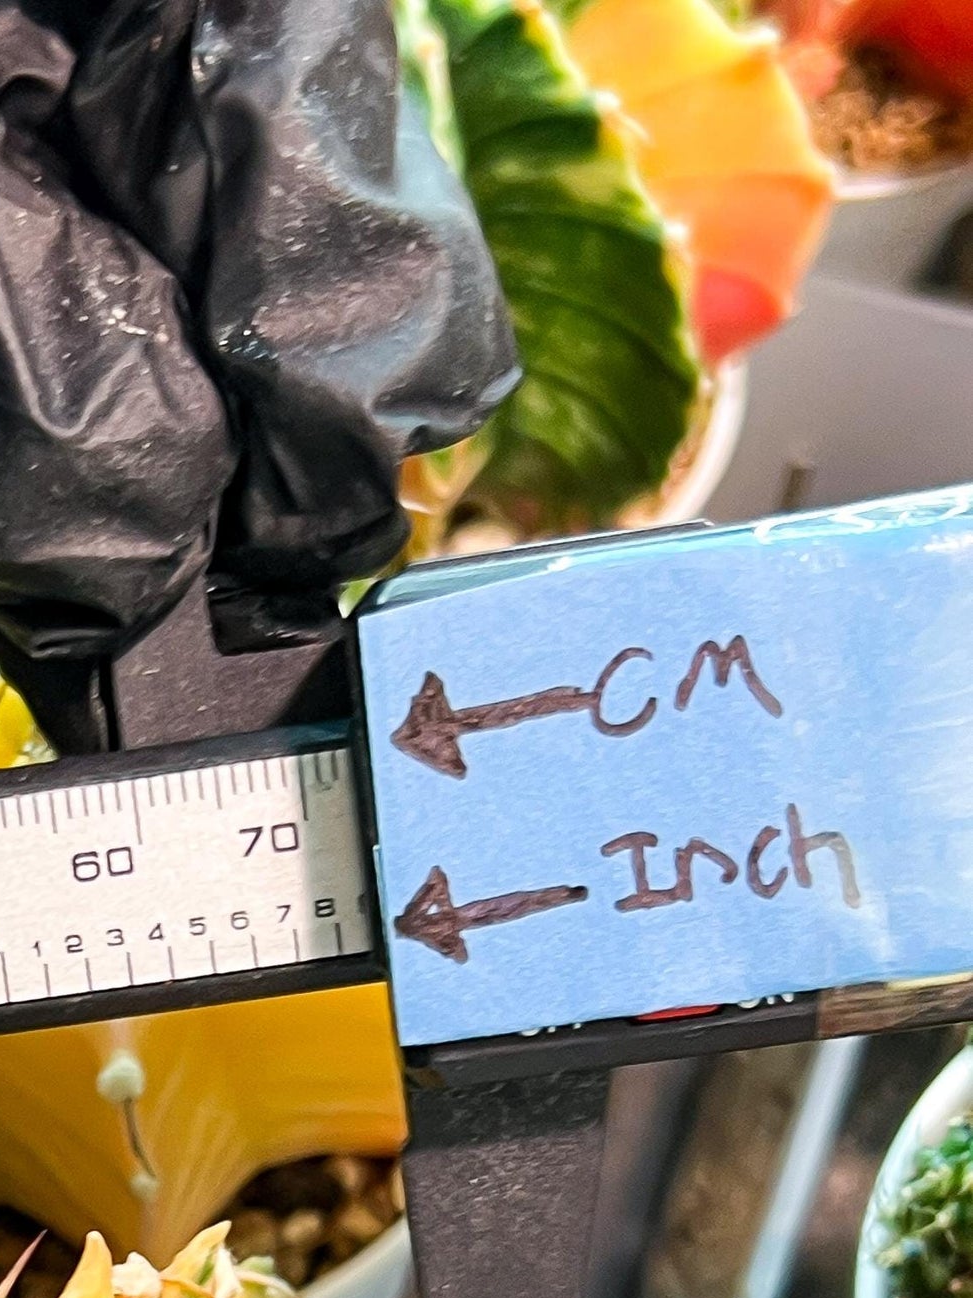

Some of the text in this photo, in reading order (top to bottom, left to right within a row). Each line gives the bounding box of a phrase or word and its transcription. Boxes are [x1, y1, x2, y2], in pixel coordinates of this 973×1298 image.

[71, 846, 135, 883] 60
[238, 821, 301, 858] 70
[600, 802, 863, 914] Inch
[32, 940, 41, 957] 1
[64, 934, 84, 954] 2
[105, 928, 125, 947] 3
[147, 922, 165, 941] 4
[188, 916, 207, 937] 5
[230, 910, 250, 931] 6
[276, 904, 292, 923] 7
[314, 897, 337, 919] 8
